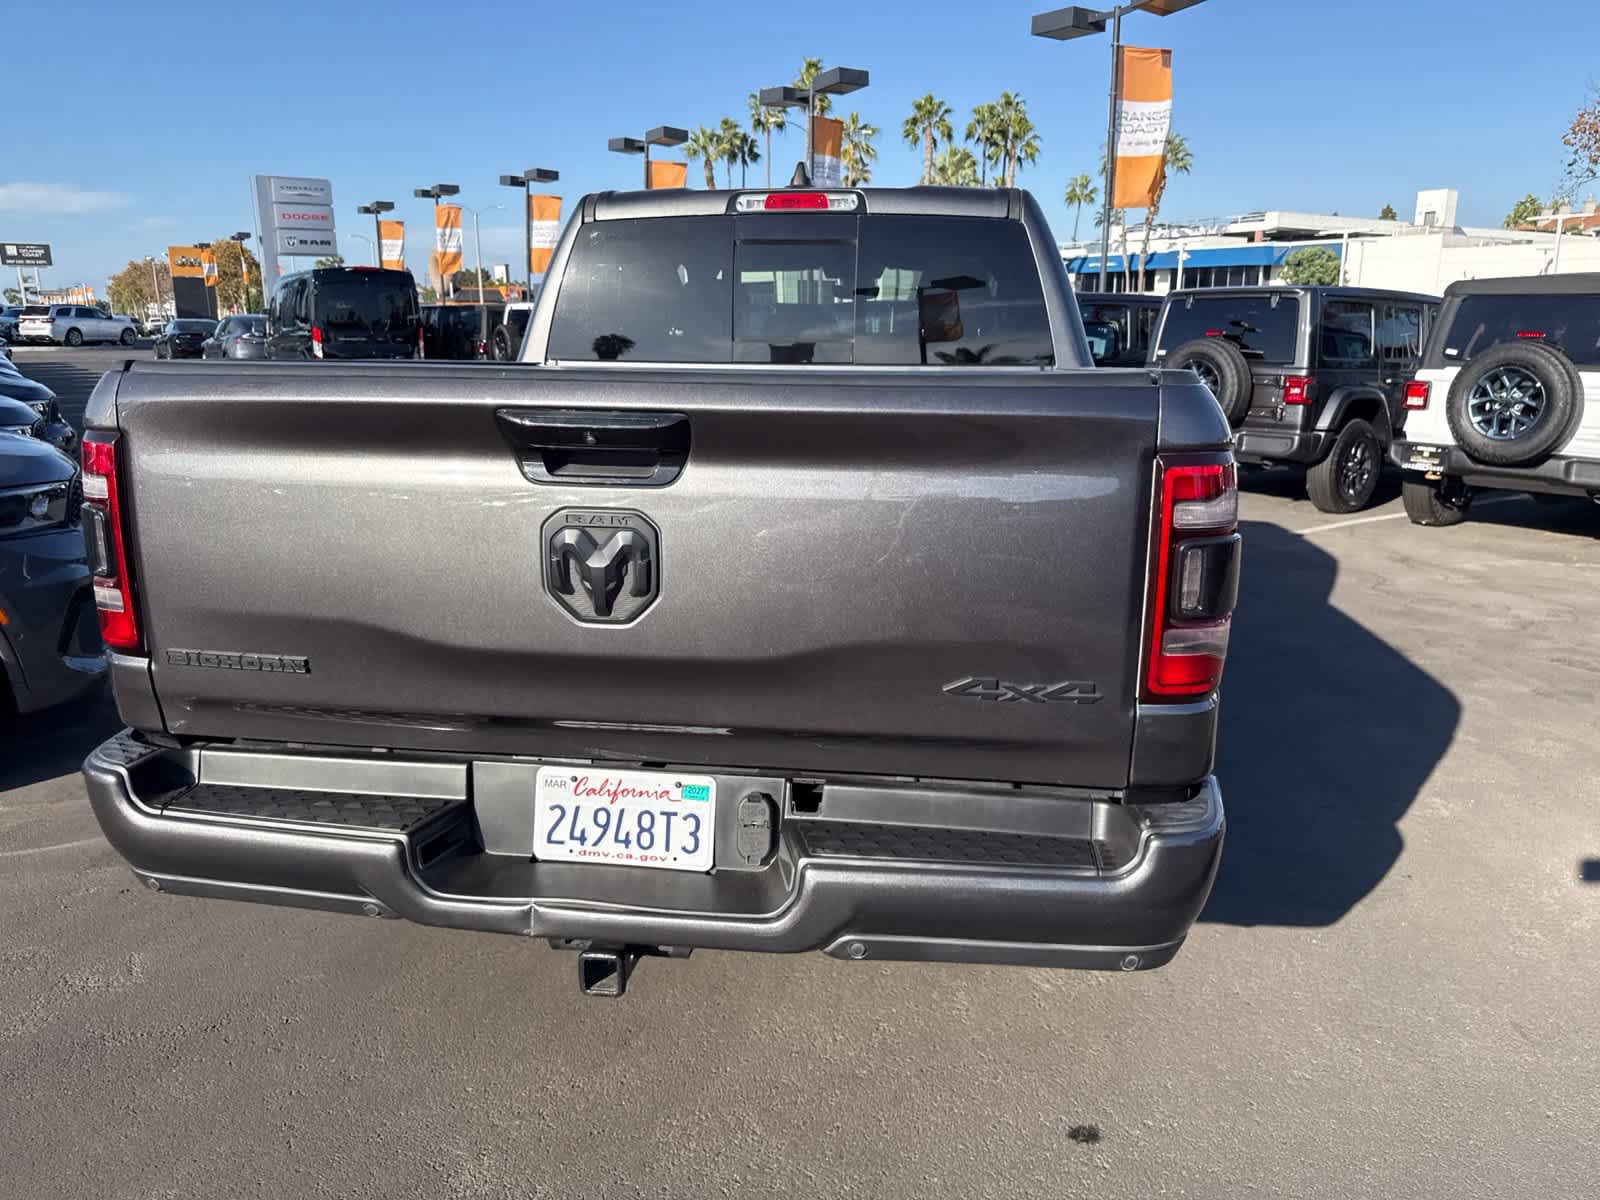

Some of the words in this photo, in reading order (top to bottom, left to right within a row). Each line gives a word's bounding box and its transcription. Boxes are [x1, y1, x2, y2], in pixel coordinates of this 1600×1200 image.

[281, 212, 329, 221] DODGE
[299, 239, 332, 247] RAM
[565, 513, 633, 526] RAM
[544, 778, 568, 789] MAR
[572, 776, 682, 805] California
[546, 804, 702, 855] 24948T3
[578, 849, 669, 863] dmv.ca.gov
